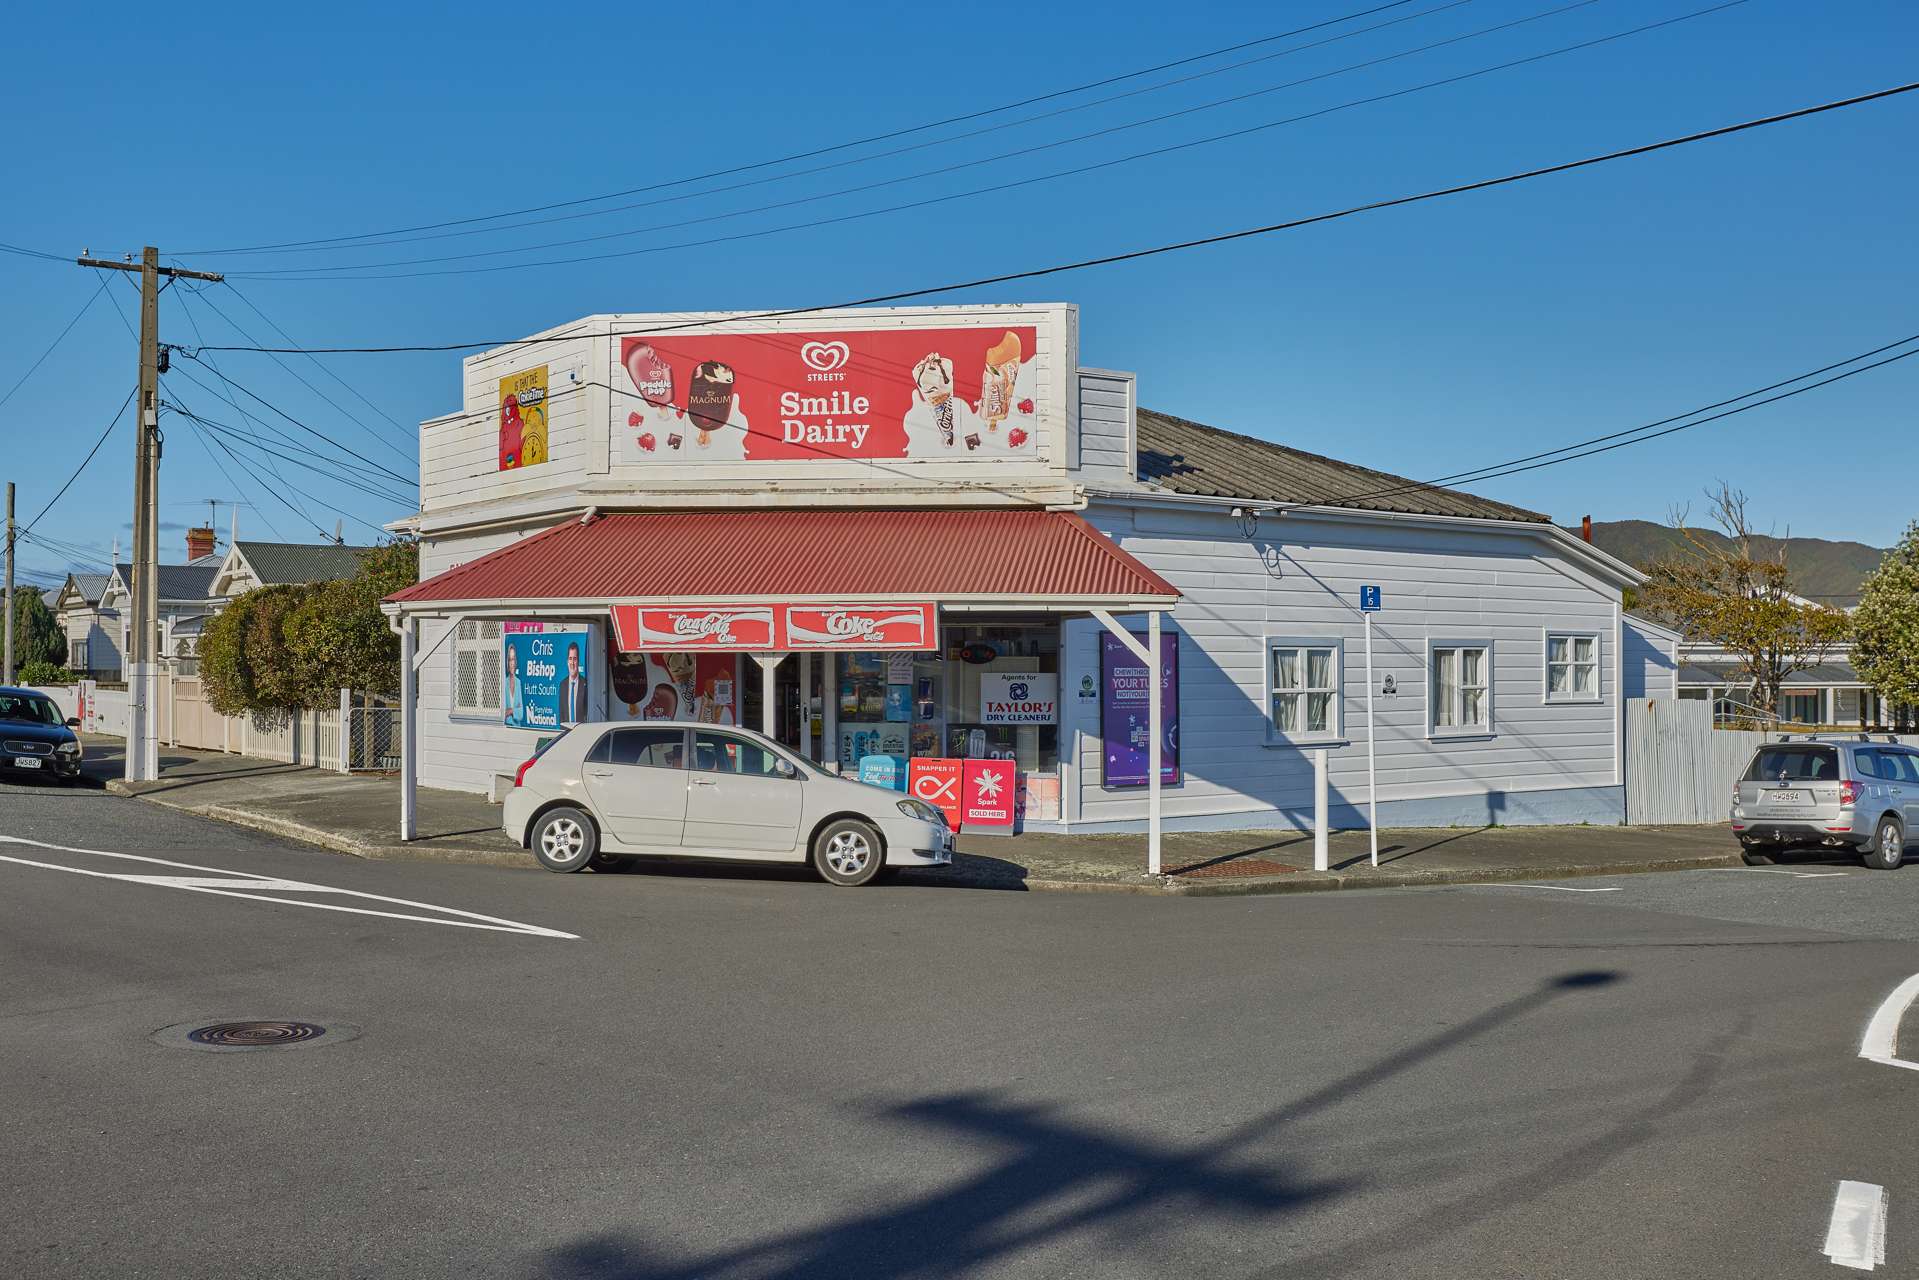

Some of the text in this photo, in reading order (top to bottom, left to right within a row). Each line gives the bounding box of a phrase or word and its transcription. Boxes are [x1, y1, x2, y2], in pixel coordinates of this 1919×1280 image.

[807, 373, 845, 382] STREETS
[690, 395, 731, 404] MAGNUM
[780, 390, 870, 417] Smile
[781, 418, 870, 449] Dairy
[1366, 586, 1374, 597] P
[826, 611, 875, 635] Coke
[531, 639, 554, 656] Chris
[526, 660, 556, 681] Bishop
[1001, 673, 1037, 682] Agents for
[1112, 678, 1138, 689] YOUR
[524, 683, 537, 695] Hutt
[538, 683, 557, 696] South
[985, 701, 1054, 713] TAYLOR'S
[525, 705, 557, 726] National
[986, 713, 1052, 721] DRY CLEANERS
[977, 798, 998, 806] Spark
[988, 810, 1005, 818] HERE
